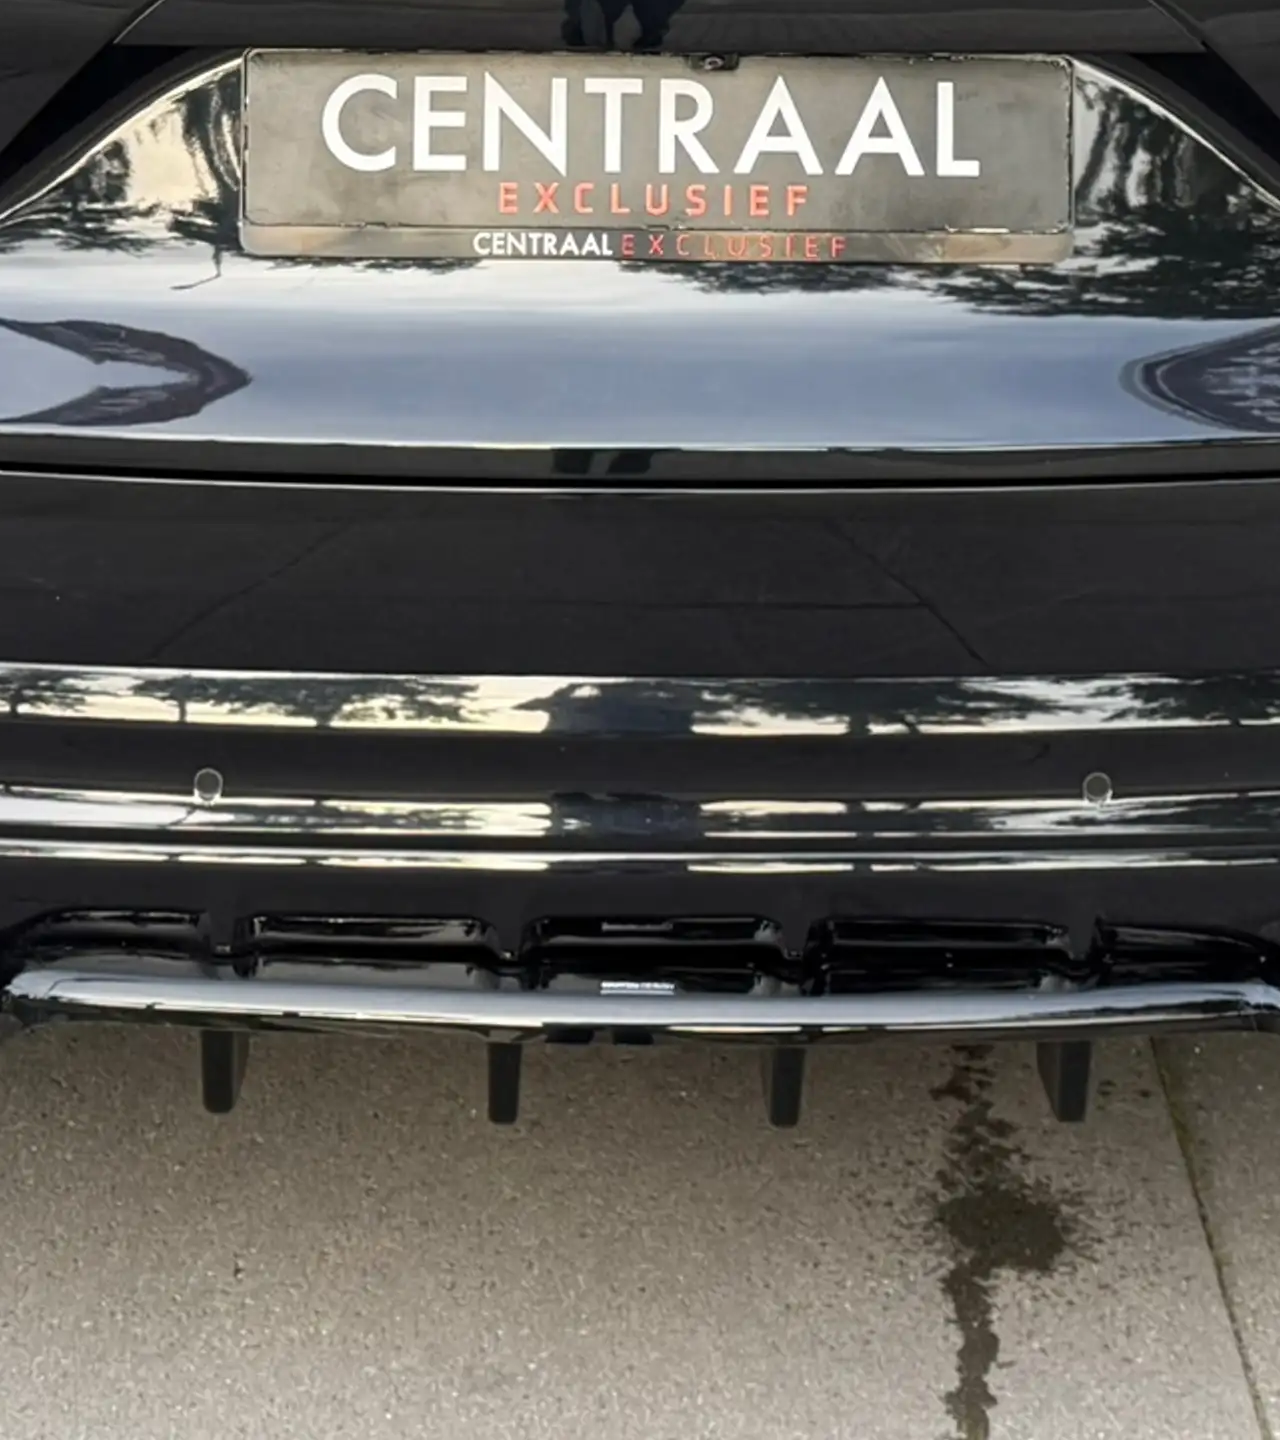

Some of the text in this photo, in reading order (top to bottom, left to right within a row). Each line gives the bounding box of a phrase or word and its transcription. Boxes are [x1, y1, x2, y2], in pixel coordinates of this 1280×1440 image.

[321, 71, 980, 177] CENTRAAL
[498, 182, 810, 216] EXCLUSIEF
[472, 231, 848, 259] CENTRAAL EXCLUSIEF
